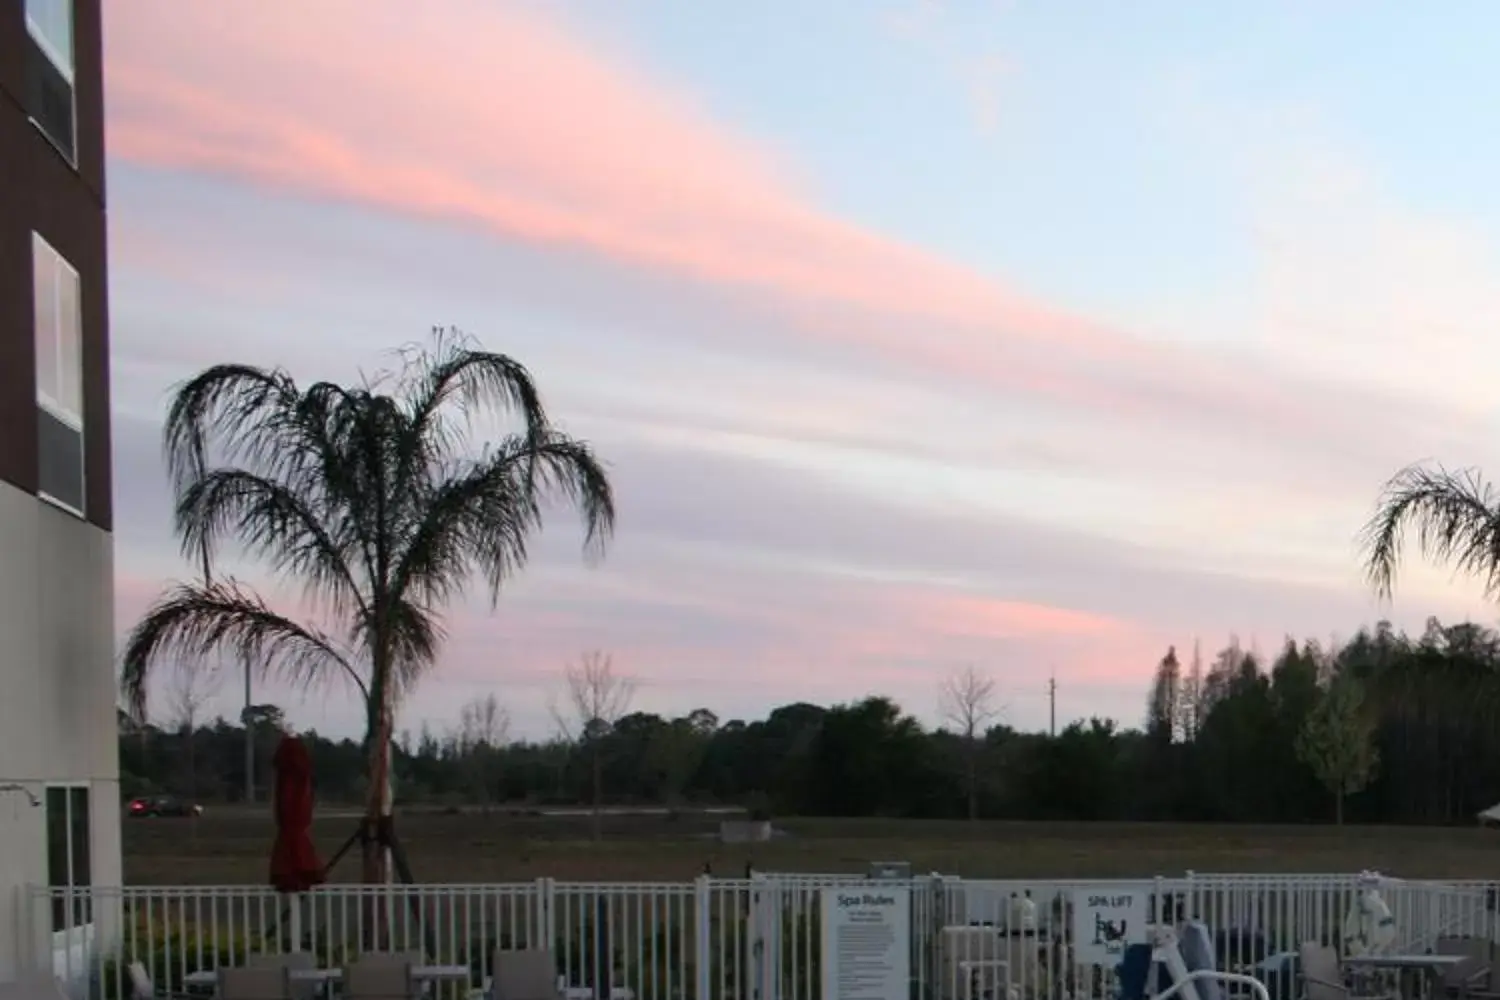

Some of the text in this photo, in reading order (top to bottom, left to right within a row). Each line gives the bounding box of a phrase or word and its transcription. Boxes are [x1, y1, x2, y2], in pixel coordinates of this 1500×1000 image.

[837, 893, 895, 906] Spa Rules
[1088, 895, 1134, 908] SPA LIFT
